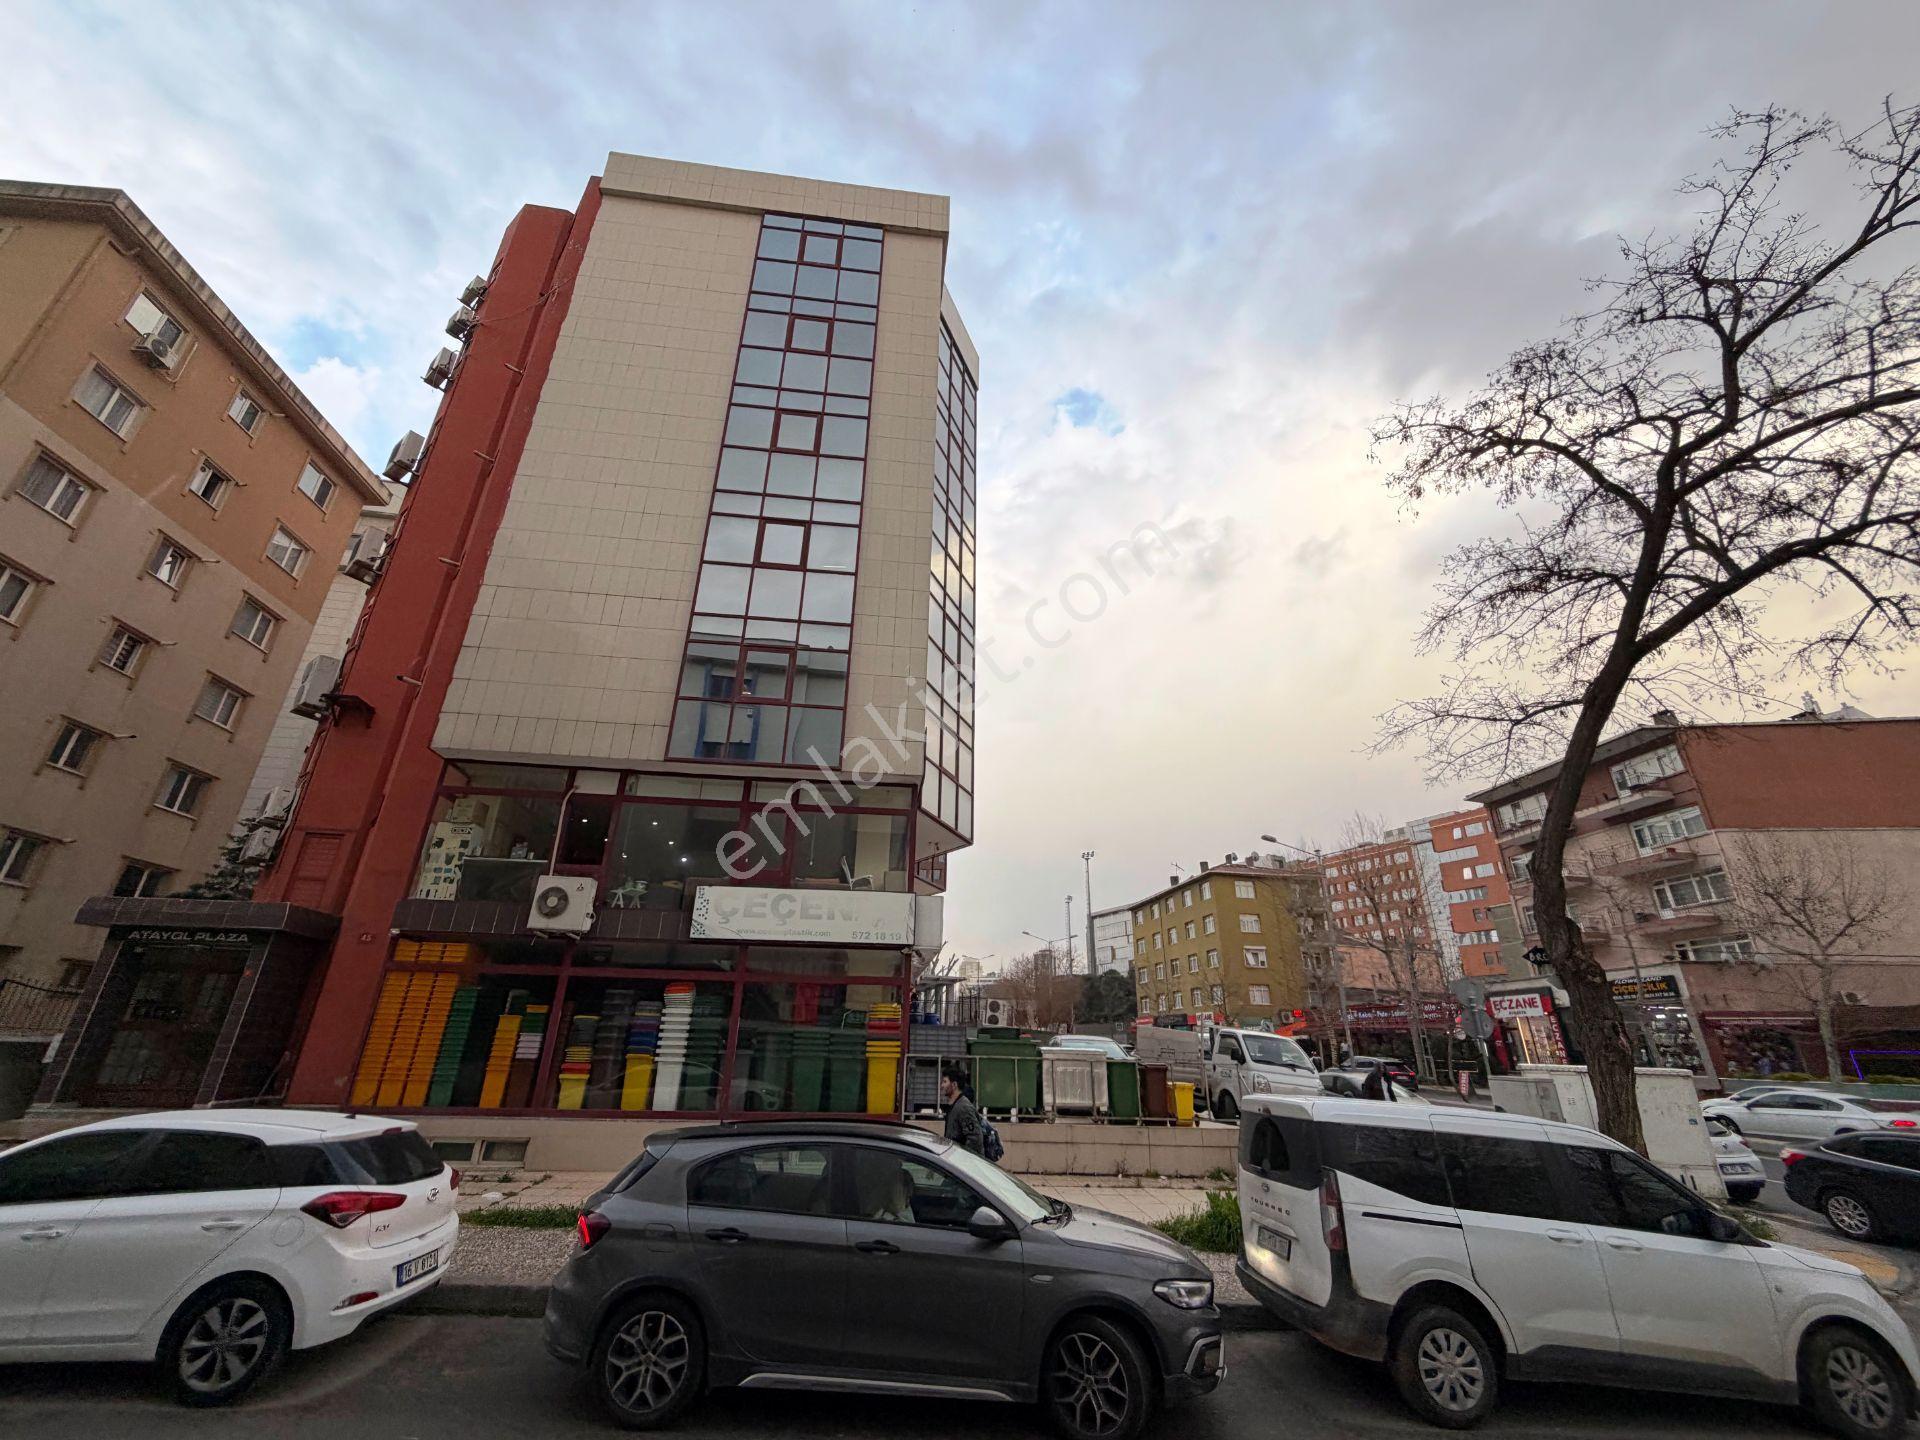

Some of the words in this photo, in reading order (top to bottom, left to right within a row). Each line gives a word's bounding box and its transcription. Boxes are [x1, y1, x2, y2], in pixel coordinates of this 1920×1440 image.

[194, 932, 249, 942] PLAZA
[851, 930, 871, 940] 572
[1492, 997, 1540, 1011] ECZANE
[404, 1263, 413, 1280] 16
[414, 1259, 420, 1274] V
